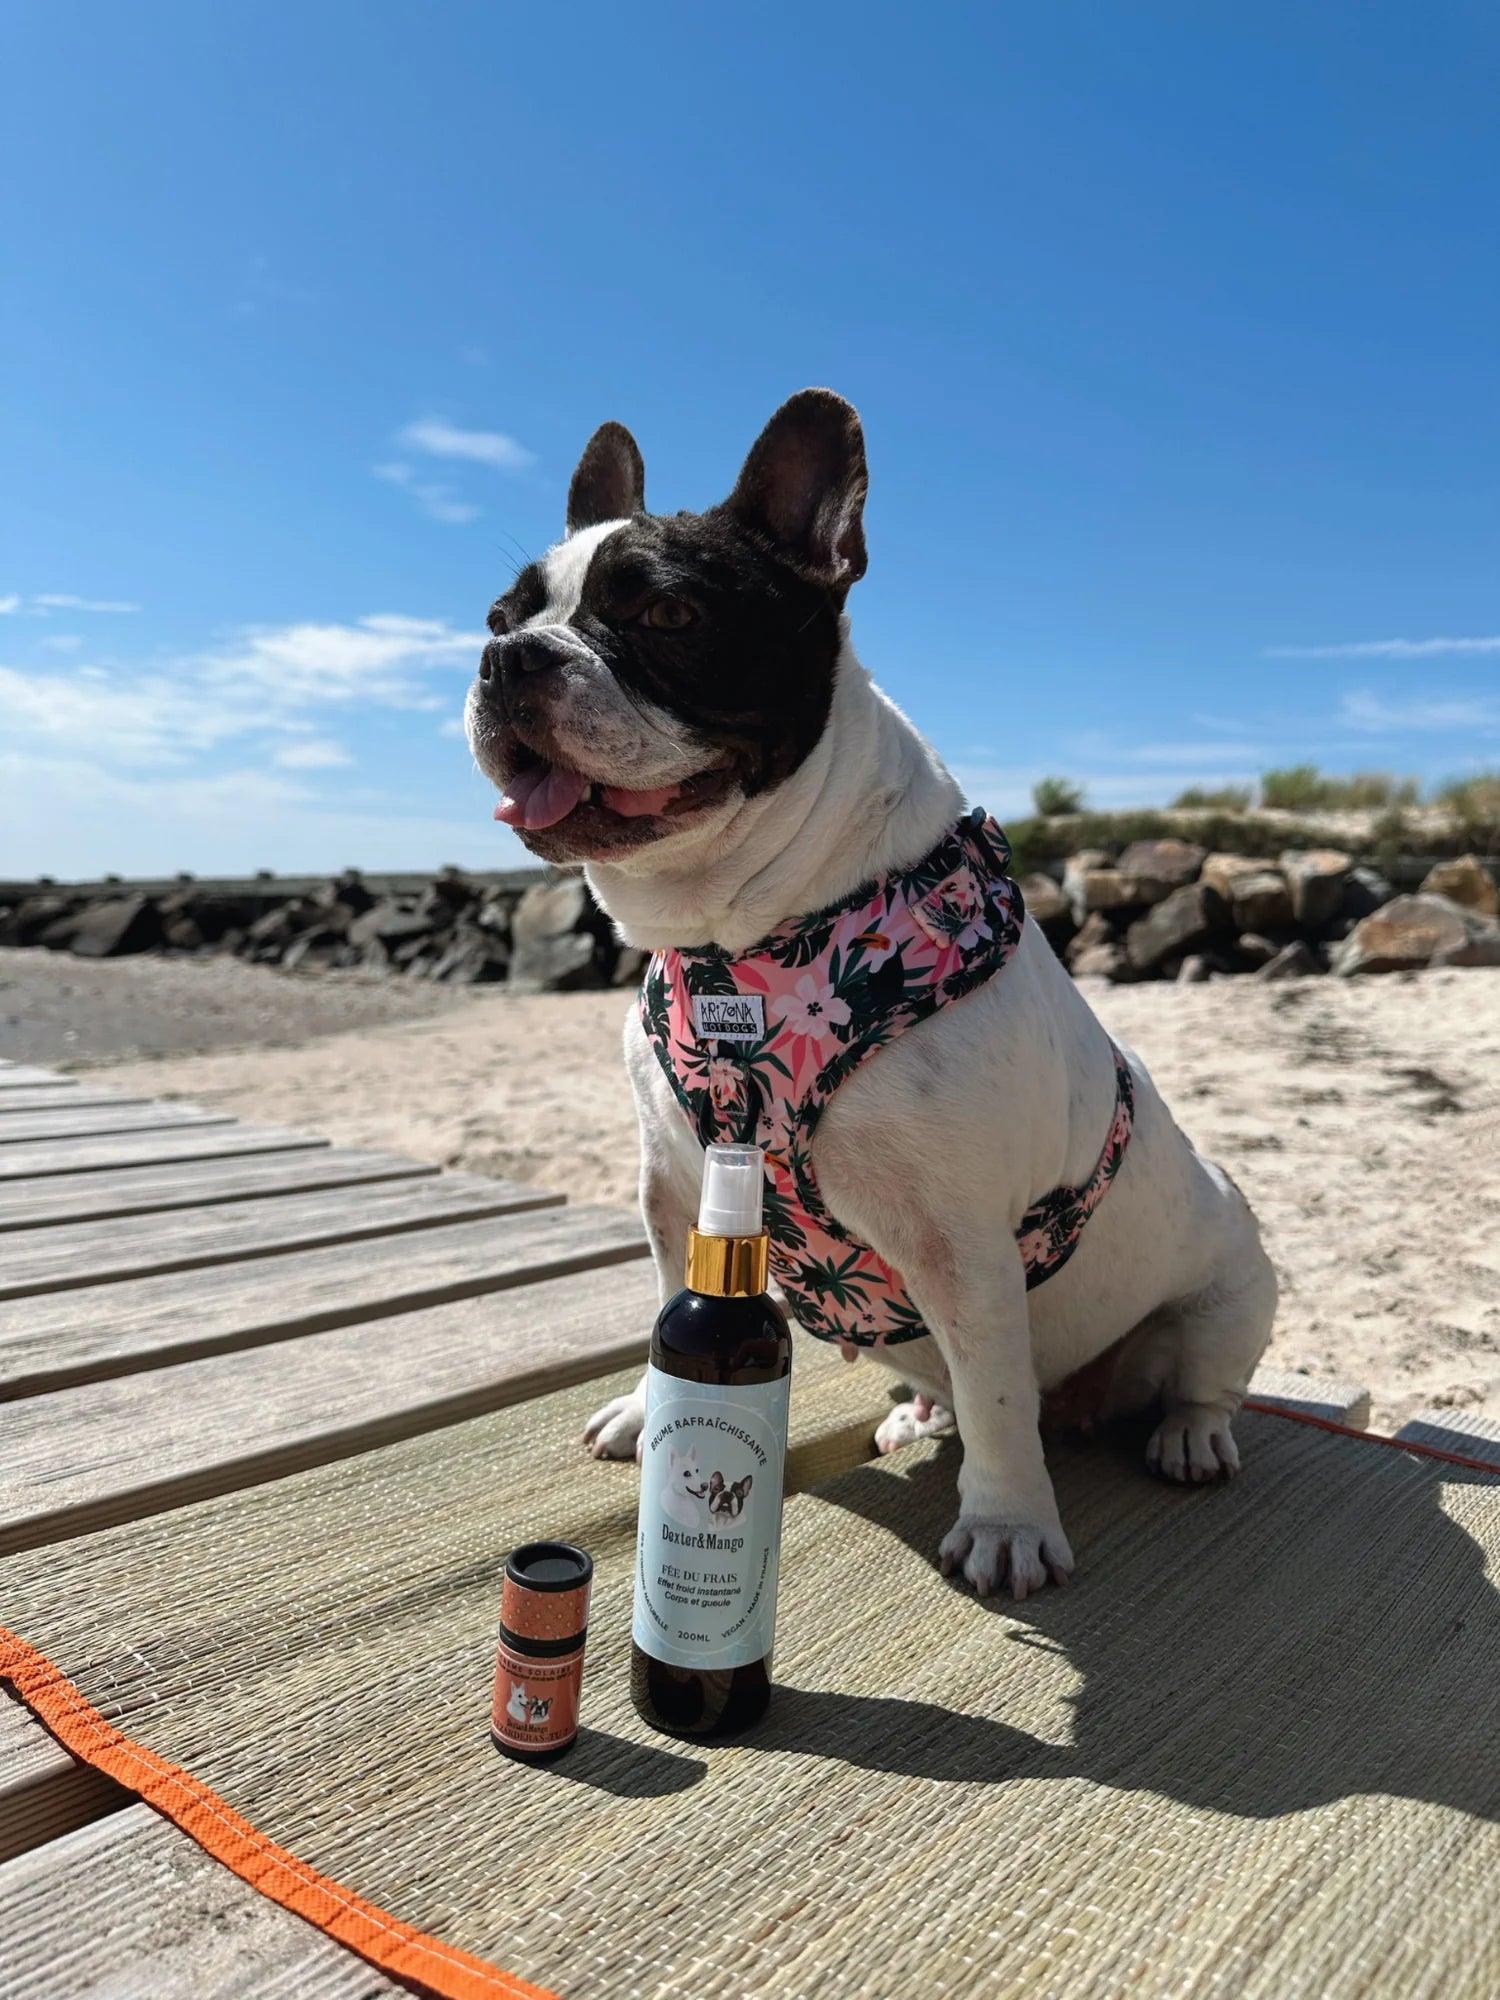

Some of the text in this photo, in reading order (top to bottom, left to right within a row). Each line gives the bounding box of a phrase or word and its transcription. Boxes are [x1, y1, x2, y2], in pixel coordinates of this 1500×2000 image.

[650, 1416, 768, 1467] BRUME RAFRAÎCHISSANTE
[662, 1523, 744, 1553] Dexter&Mango
[657, 1577, 675, 1589] Effet
[676, 1583, 696, 1594] froid
[683, 1570, 700, 1582] DU
[703, 1573, 738, 1583] FRAIS
[664, 1591, 731, 1608] Corps et gueule
[644, 1592, 669, 1631] NATURELLE
[721, 1617, 745, 1638] VEGAN
[746, 1591, 760, 1614] MADE
[677, 1631, 711, 1642] 200ML
